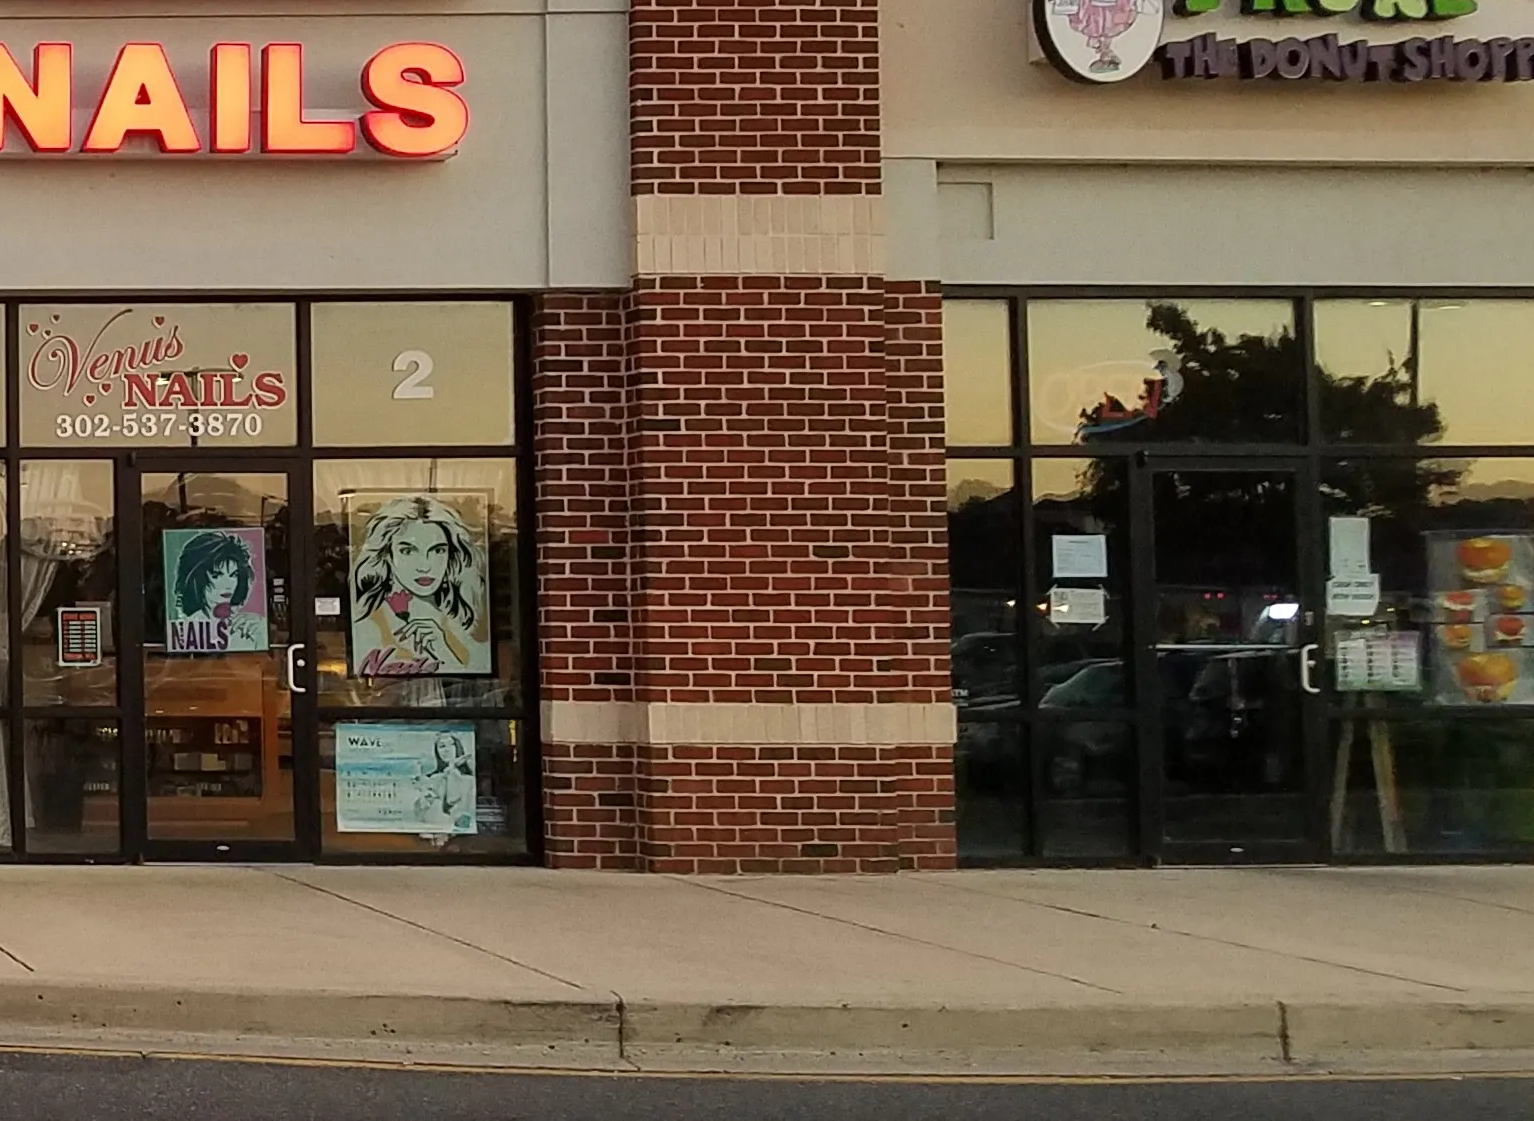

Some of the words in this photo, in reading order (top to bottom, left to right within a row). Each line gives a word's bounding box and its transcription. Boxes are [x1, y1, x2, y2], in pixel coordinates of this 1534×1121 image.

[1165, 32, 1240, 80] THE
[1250, 33, 1395, 80] DONUT
[28, 308, 185, 396] Venus
[121, 370, 287, 410] NAILS
[392, 350, 435, 399] 2
[56, 413, 262, 438] 302-537-3870
[171, 621, 229, 651] NAILS
[359, 647, 441, 677] Nails
